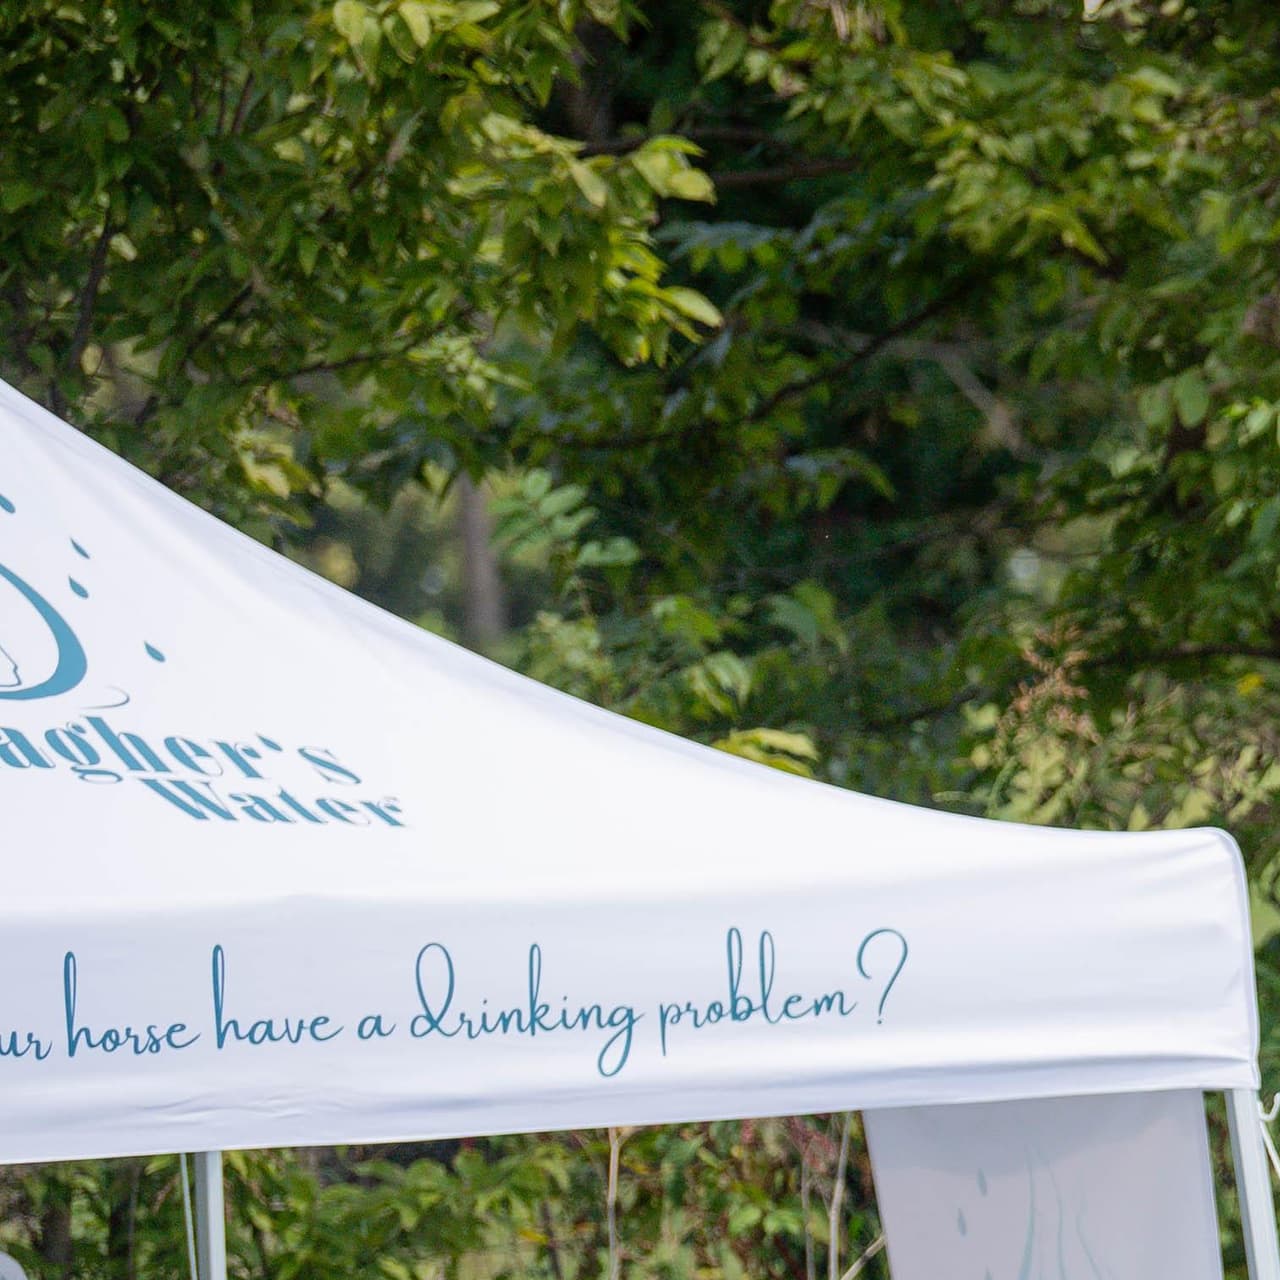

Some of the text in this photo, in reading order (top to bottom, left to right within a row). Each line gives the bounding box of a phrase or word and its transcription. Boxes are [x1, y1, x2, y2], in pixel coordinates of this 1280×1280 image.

[135, 777, 408, 828] Water
[64, 950, 201, 1058] horse
[212, 943, 344, 1049] have
[356, 1012, 396, 1040] a
[409, 942, 645, 1078] drinking
[659, 926, 908, 1057] problem?
